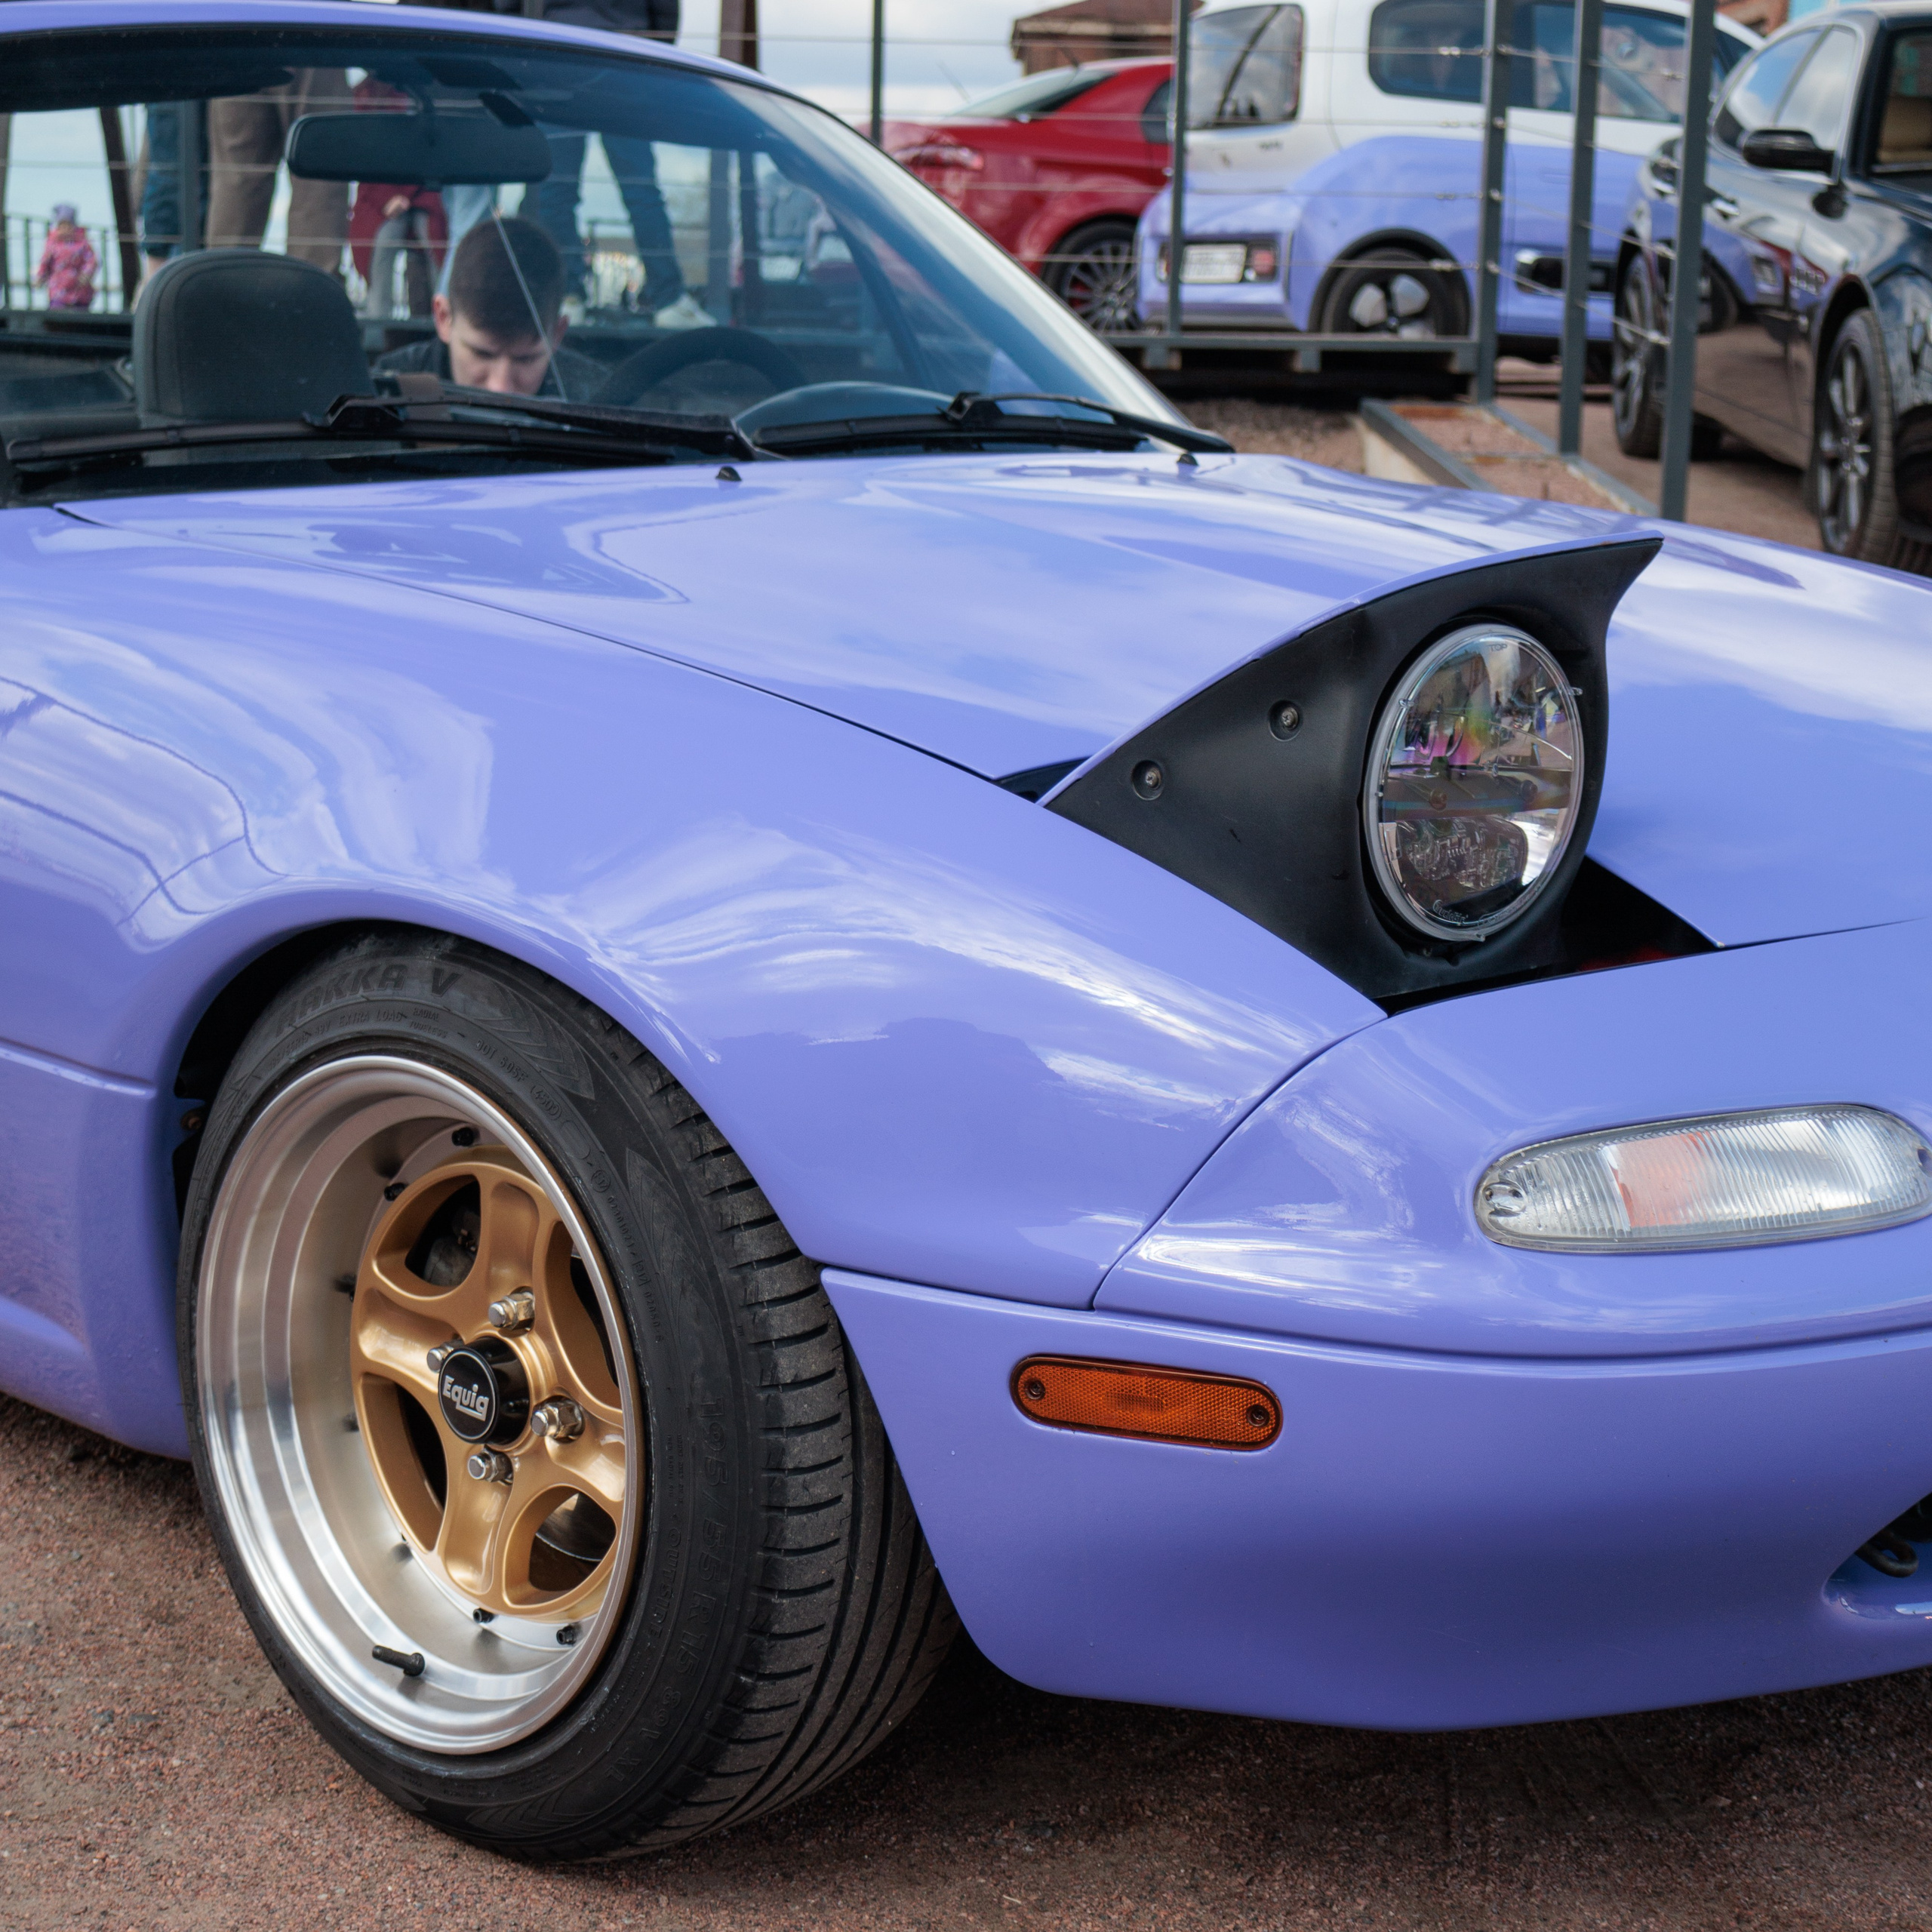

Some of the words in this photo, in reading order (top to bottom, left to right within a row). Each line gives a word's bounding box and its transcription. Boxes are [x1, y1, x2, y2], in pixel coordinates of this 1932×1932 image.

[431, 967, 463, 998] V
[339, 1011, 370, 1026] EXTRA
[376, 1009, 403, 1023] LOAD
[413, 1007, 440, 1023] RADIAL
[649, 1527, 682, 1638] OUTSIDE
